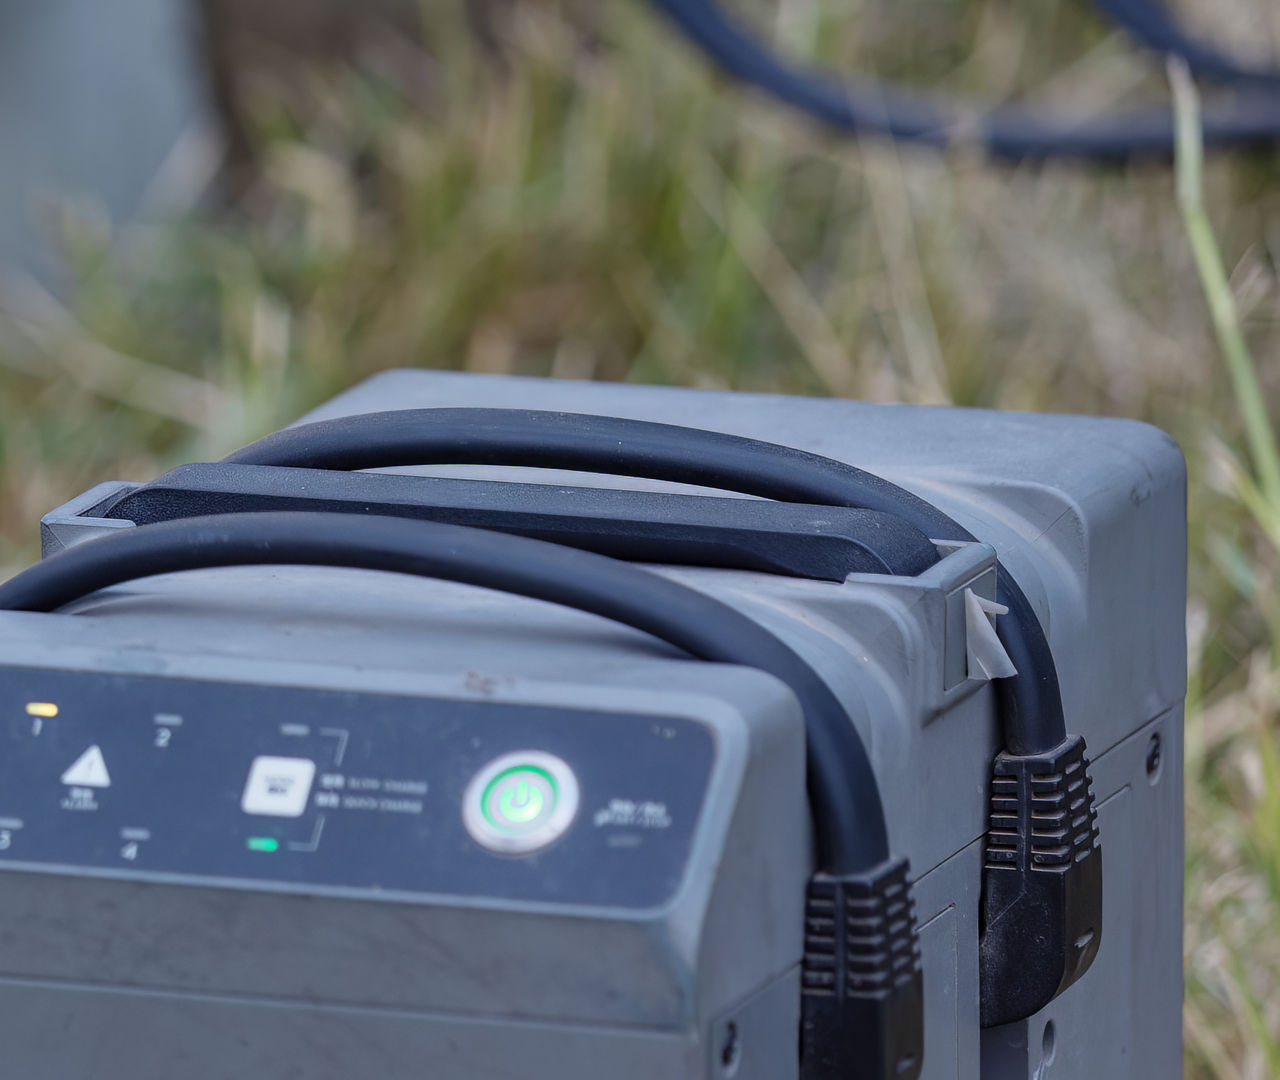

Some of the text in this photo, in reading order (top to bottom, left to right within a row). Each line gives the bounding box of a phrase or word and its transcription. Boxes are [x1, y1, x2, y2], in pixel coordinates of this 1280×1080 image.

[32, 717, 43, 737] 1
[155, 726, 172, 748] 2
[121, 841, 139, 861] 4
